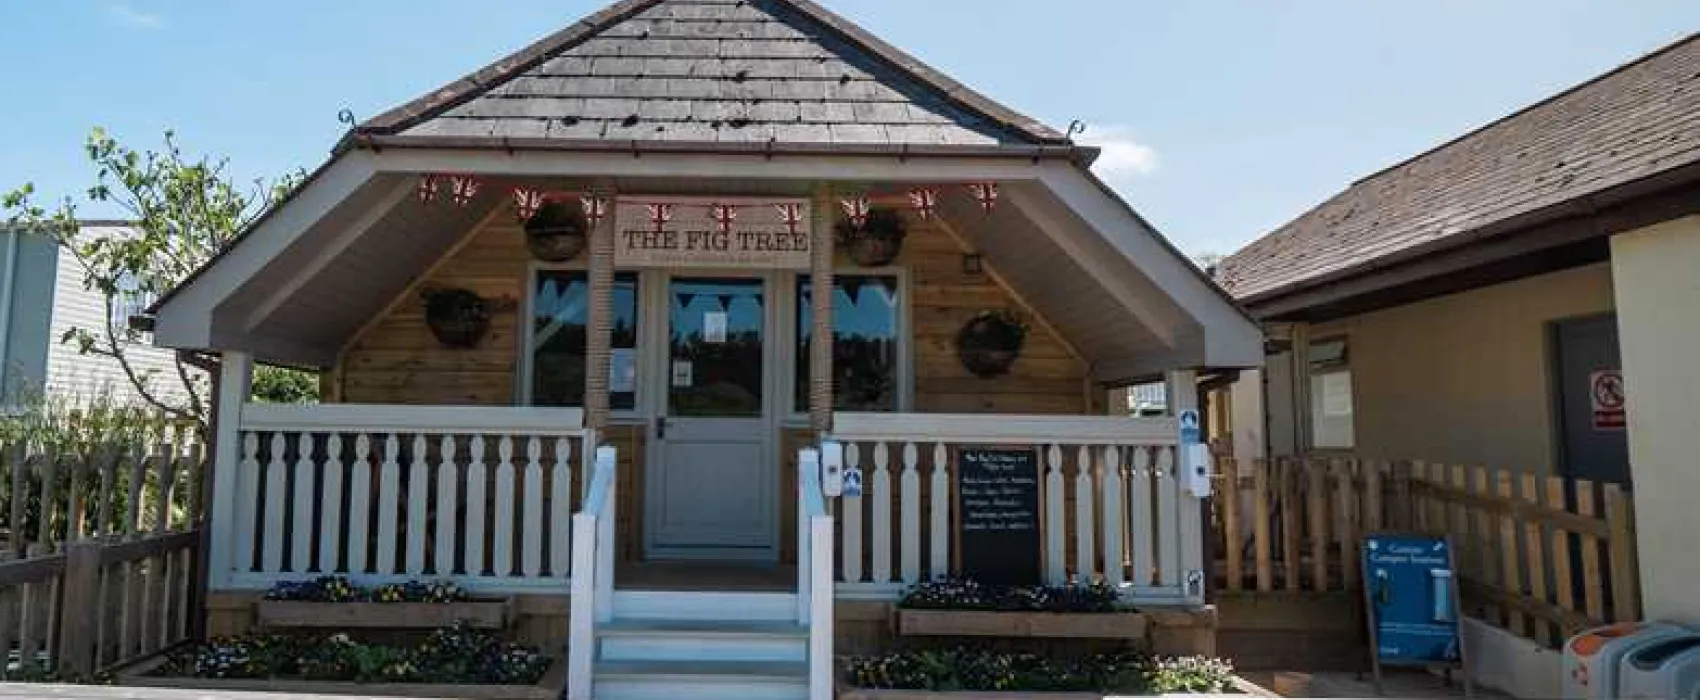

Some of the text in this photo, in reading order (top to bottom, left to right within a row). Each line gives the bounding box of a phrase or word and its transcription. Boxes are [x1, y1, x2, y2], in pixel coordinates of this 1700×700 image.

[623, 231, 808, 251] THE FIG TREE
